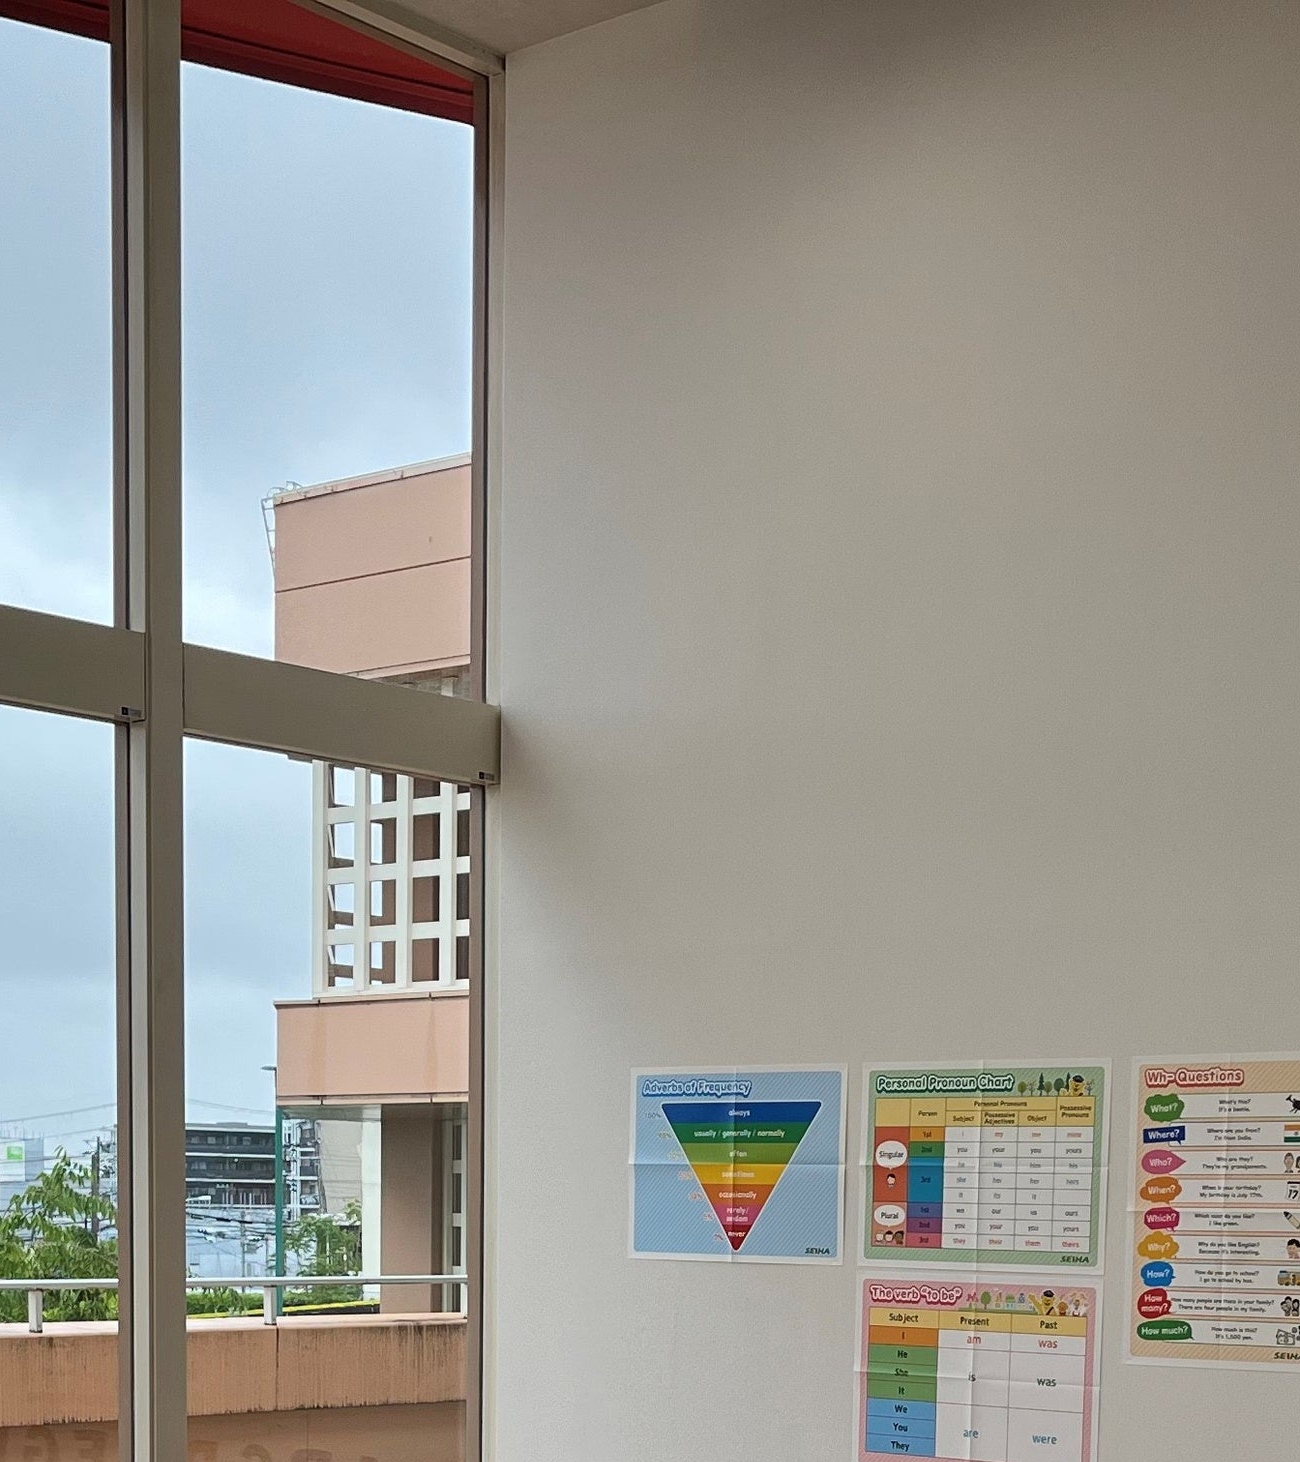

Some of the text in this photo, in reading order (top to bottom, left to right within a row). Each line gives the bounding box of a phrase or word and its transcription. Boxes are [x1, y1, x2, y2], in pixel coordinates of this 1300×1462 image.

[877, 1075, 1014, 1090] Personal Pronoun Chart
[643, 1080, 751, 1097] Adverbs of Frequency
[1150, 1102, 1178, 1113] What?
[728, 1110, 750, 1118] always
[953, 1115, 975, 1123] Subject
[984, 1118, 1016, 1126] Adjectives
[694, 1129, 785, 1139] usually generally normally
[1148, 1128, 1180, 1140] Where?
[878, 1150, 904, 1159] Singular
[1149, 1157, 1172, 1167] Who?
[1147, 1184, 1176, 1195] When?
[1288, 1189, 1299, 1199] 17
[719, 1191, 757, 1199] occasionally
[880, 1211, 899, 1219] Plural
[1146, 1213, 1177, 1223] Which?
[1147, 1242, 1170, 1253] Why?
[1060, 1256, 1090, 1264] SEIHA
[1146, 1269, 1170, 1279] How?
[871, 1286, 893, 1299] The
[894, 1287, 920, 1300] verb
[1144, 1294, 1163, 1302] How
[1140, 1303, 1168, 1314] many?
[889, 1313, 918, 1323] Subject
[960, 1316, 990, 1326] Present
[1039, 1320, 1058, 1330] Past
[1141, 1325, 1189, 1335] How much?
[966, 1335, 981, 1344] am
[1038, 1339, 1058, 1349] was
[897, 1350, 908, 1359] He
[894, 1368, 908, 1377] She
[968, 1372, 976, 1382] is
[1036, 1377, 1057, 1387] was
[898, 1386, 905, 1395] It
[894, 1404, 908, 1413] We
[893, 1422, 908, 1432] You
[963, 1429, 979, 1438] are
[1032, 1434, 1057, 1445] were
[891, 1441, 910, 1452] They
